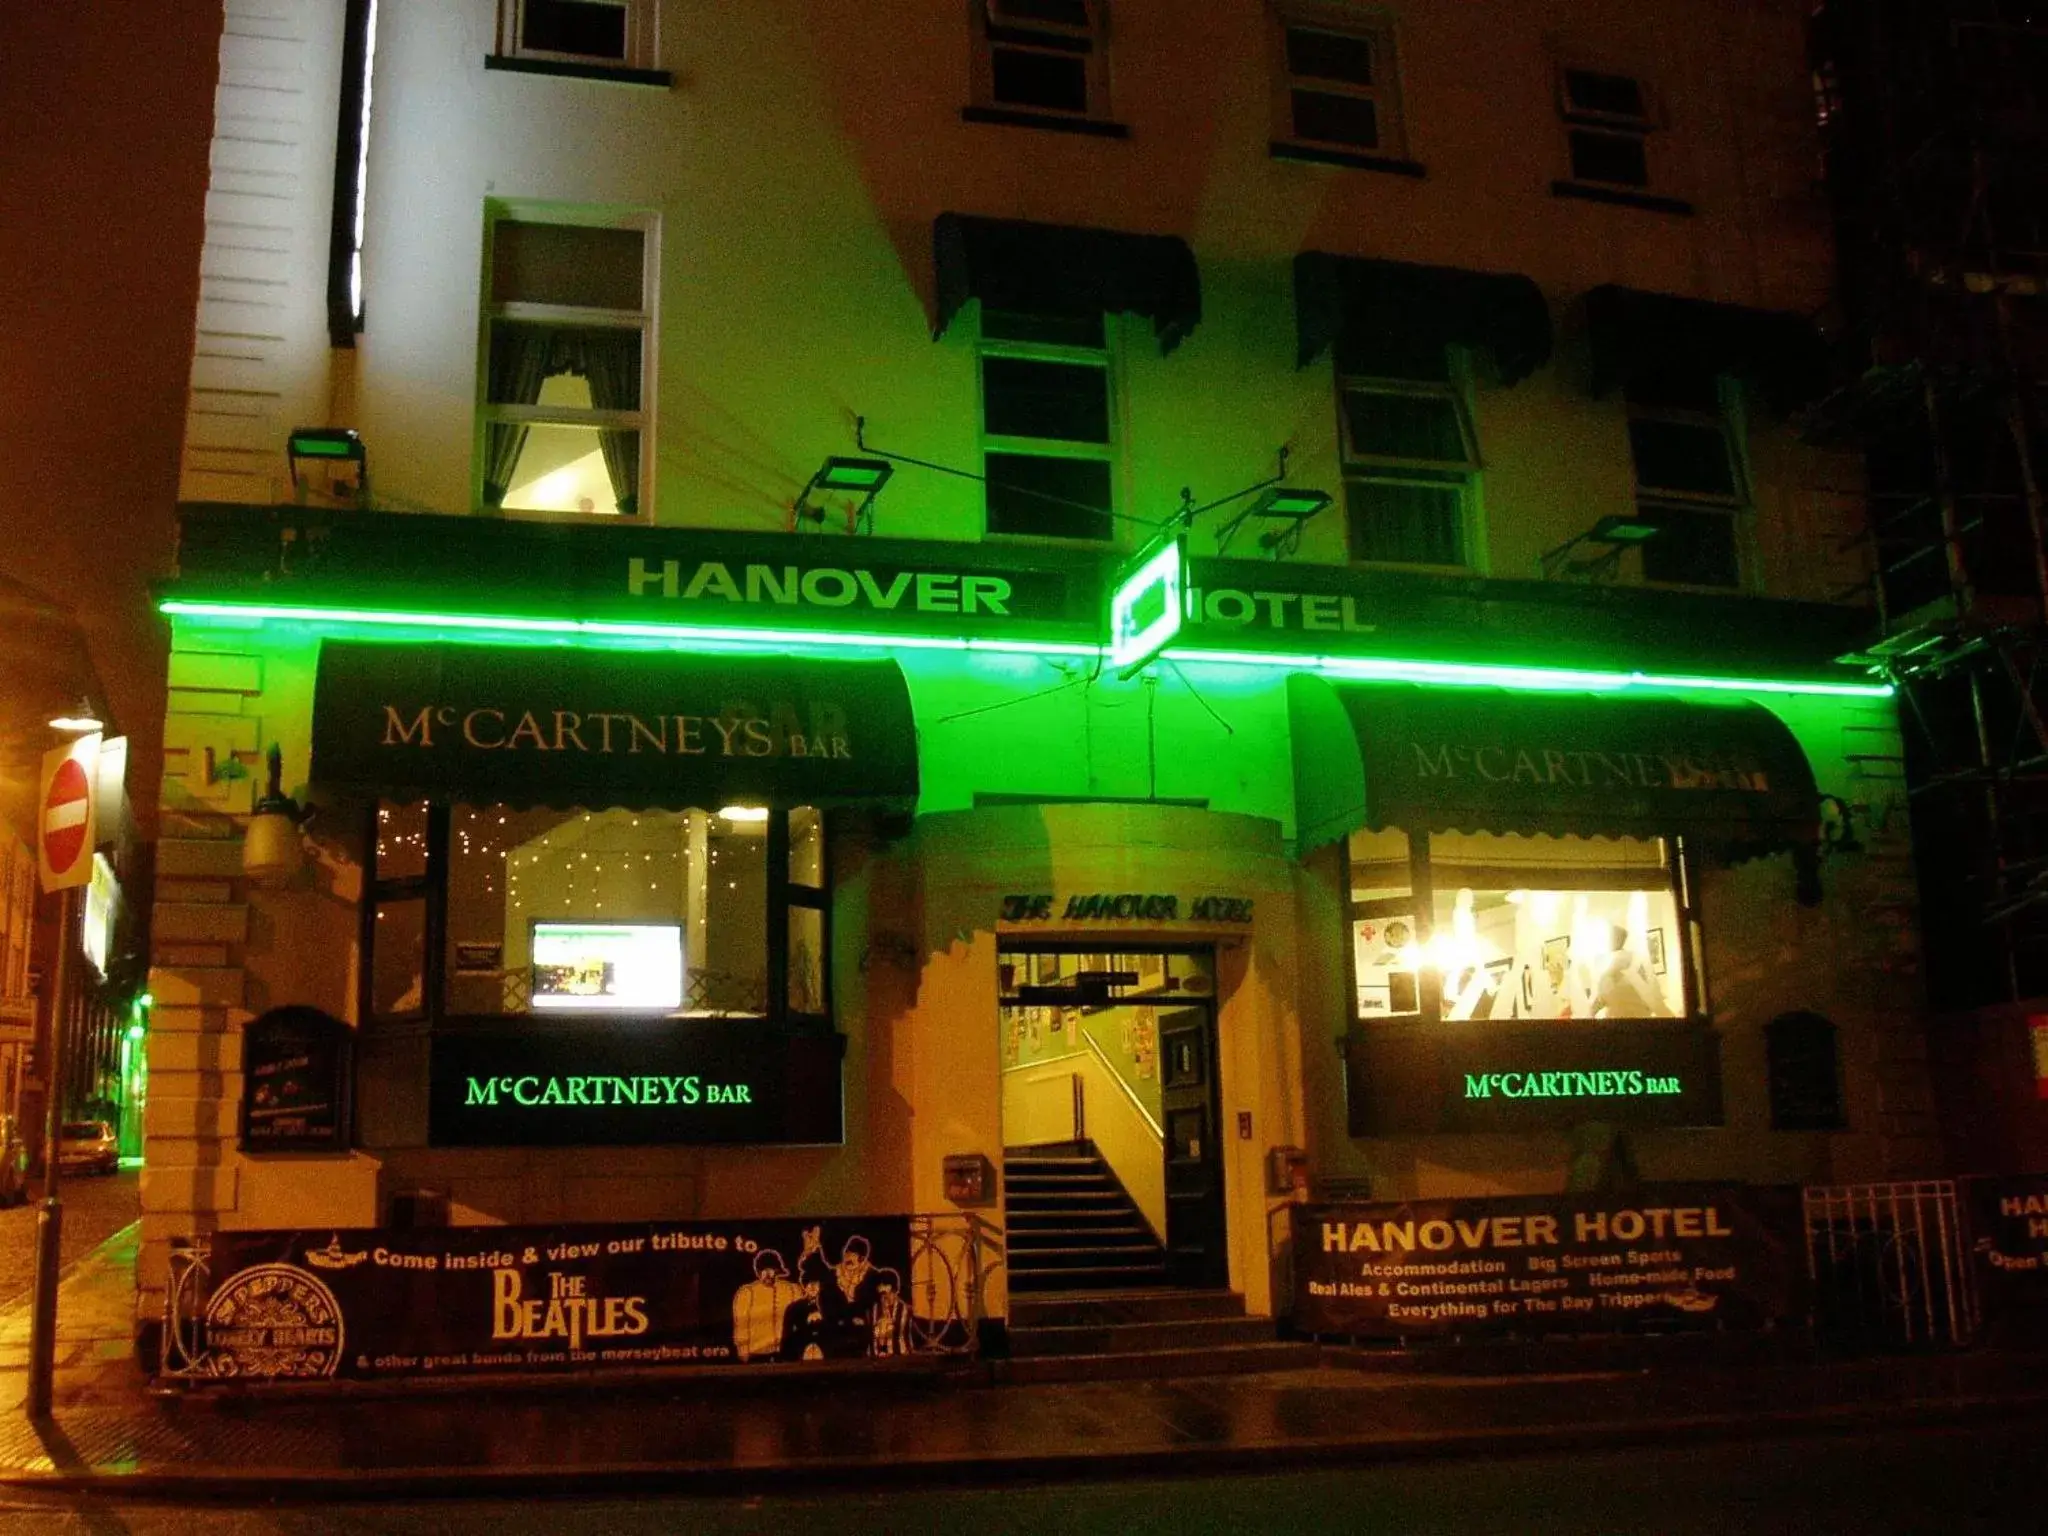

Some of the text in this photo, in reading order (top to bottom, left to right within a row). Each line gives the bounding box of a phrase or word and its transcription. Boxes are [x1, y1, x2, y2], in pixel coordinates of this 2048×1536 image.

[628, 556, 1013, 618] HANOVER
[379, 704, 853, 761] McCARTNEYS BAR
[464, 1076, 752, 1106] McCARTNEYS BAR
[1464, 1070, 1682, 1098] McCARTNEYS BAR
[1999, 1193, 2048, 1216] HA
[1322, 1207, 1733, 1253] HANOVER HOTEL
[373, 1232, 759, 1271] Come inside & view our tribute to
[1361, 1249, 1683, 1278] Accommodation Big Screen Sports
[548, 1271, 587, 1298] THE
[1308, 1280, 1337, 1297] Real
[1340, 1281, 1374, 1297] Ales
[1377, 1281, 1392, 1298] &
[1396, 1279, 1504, 1297] Continental
[1509, 1277, 1569, 1294] Lagers
[1693, 1265, 1737, 1282] Food
[491, 1268, 651, 1350] BEATLES
[1388, 1301, 1489, 1320] Everything
[1493, 1299, 1519, 1314] for
[1523, 1297, 1557, 1314] The
[1560, 1296, 1595, 1313] Day
[374, 1353, 417, 1368] other
[423, 1352, 468, 1368] great
[526, 1348, 565, 1365] from
[570, 1347, 596, 1362] the
